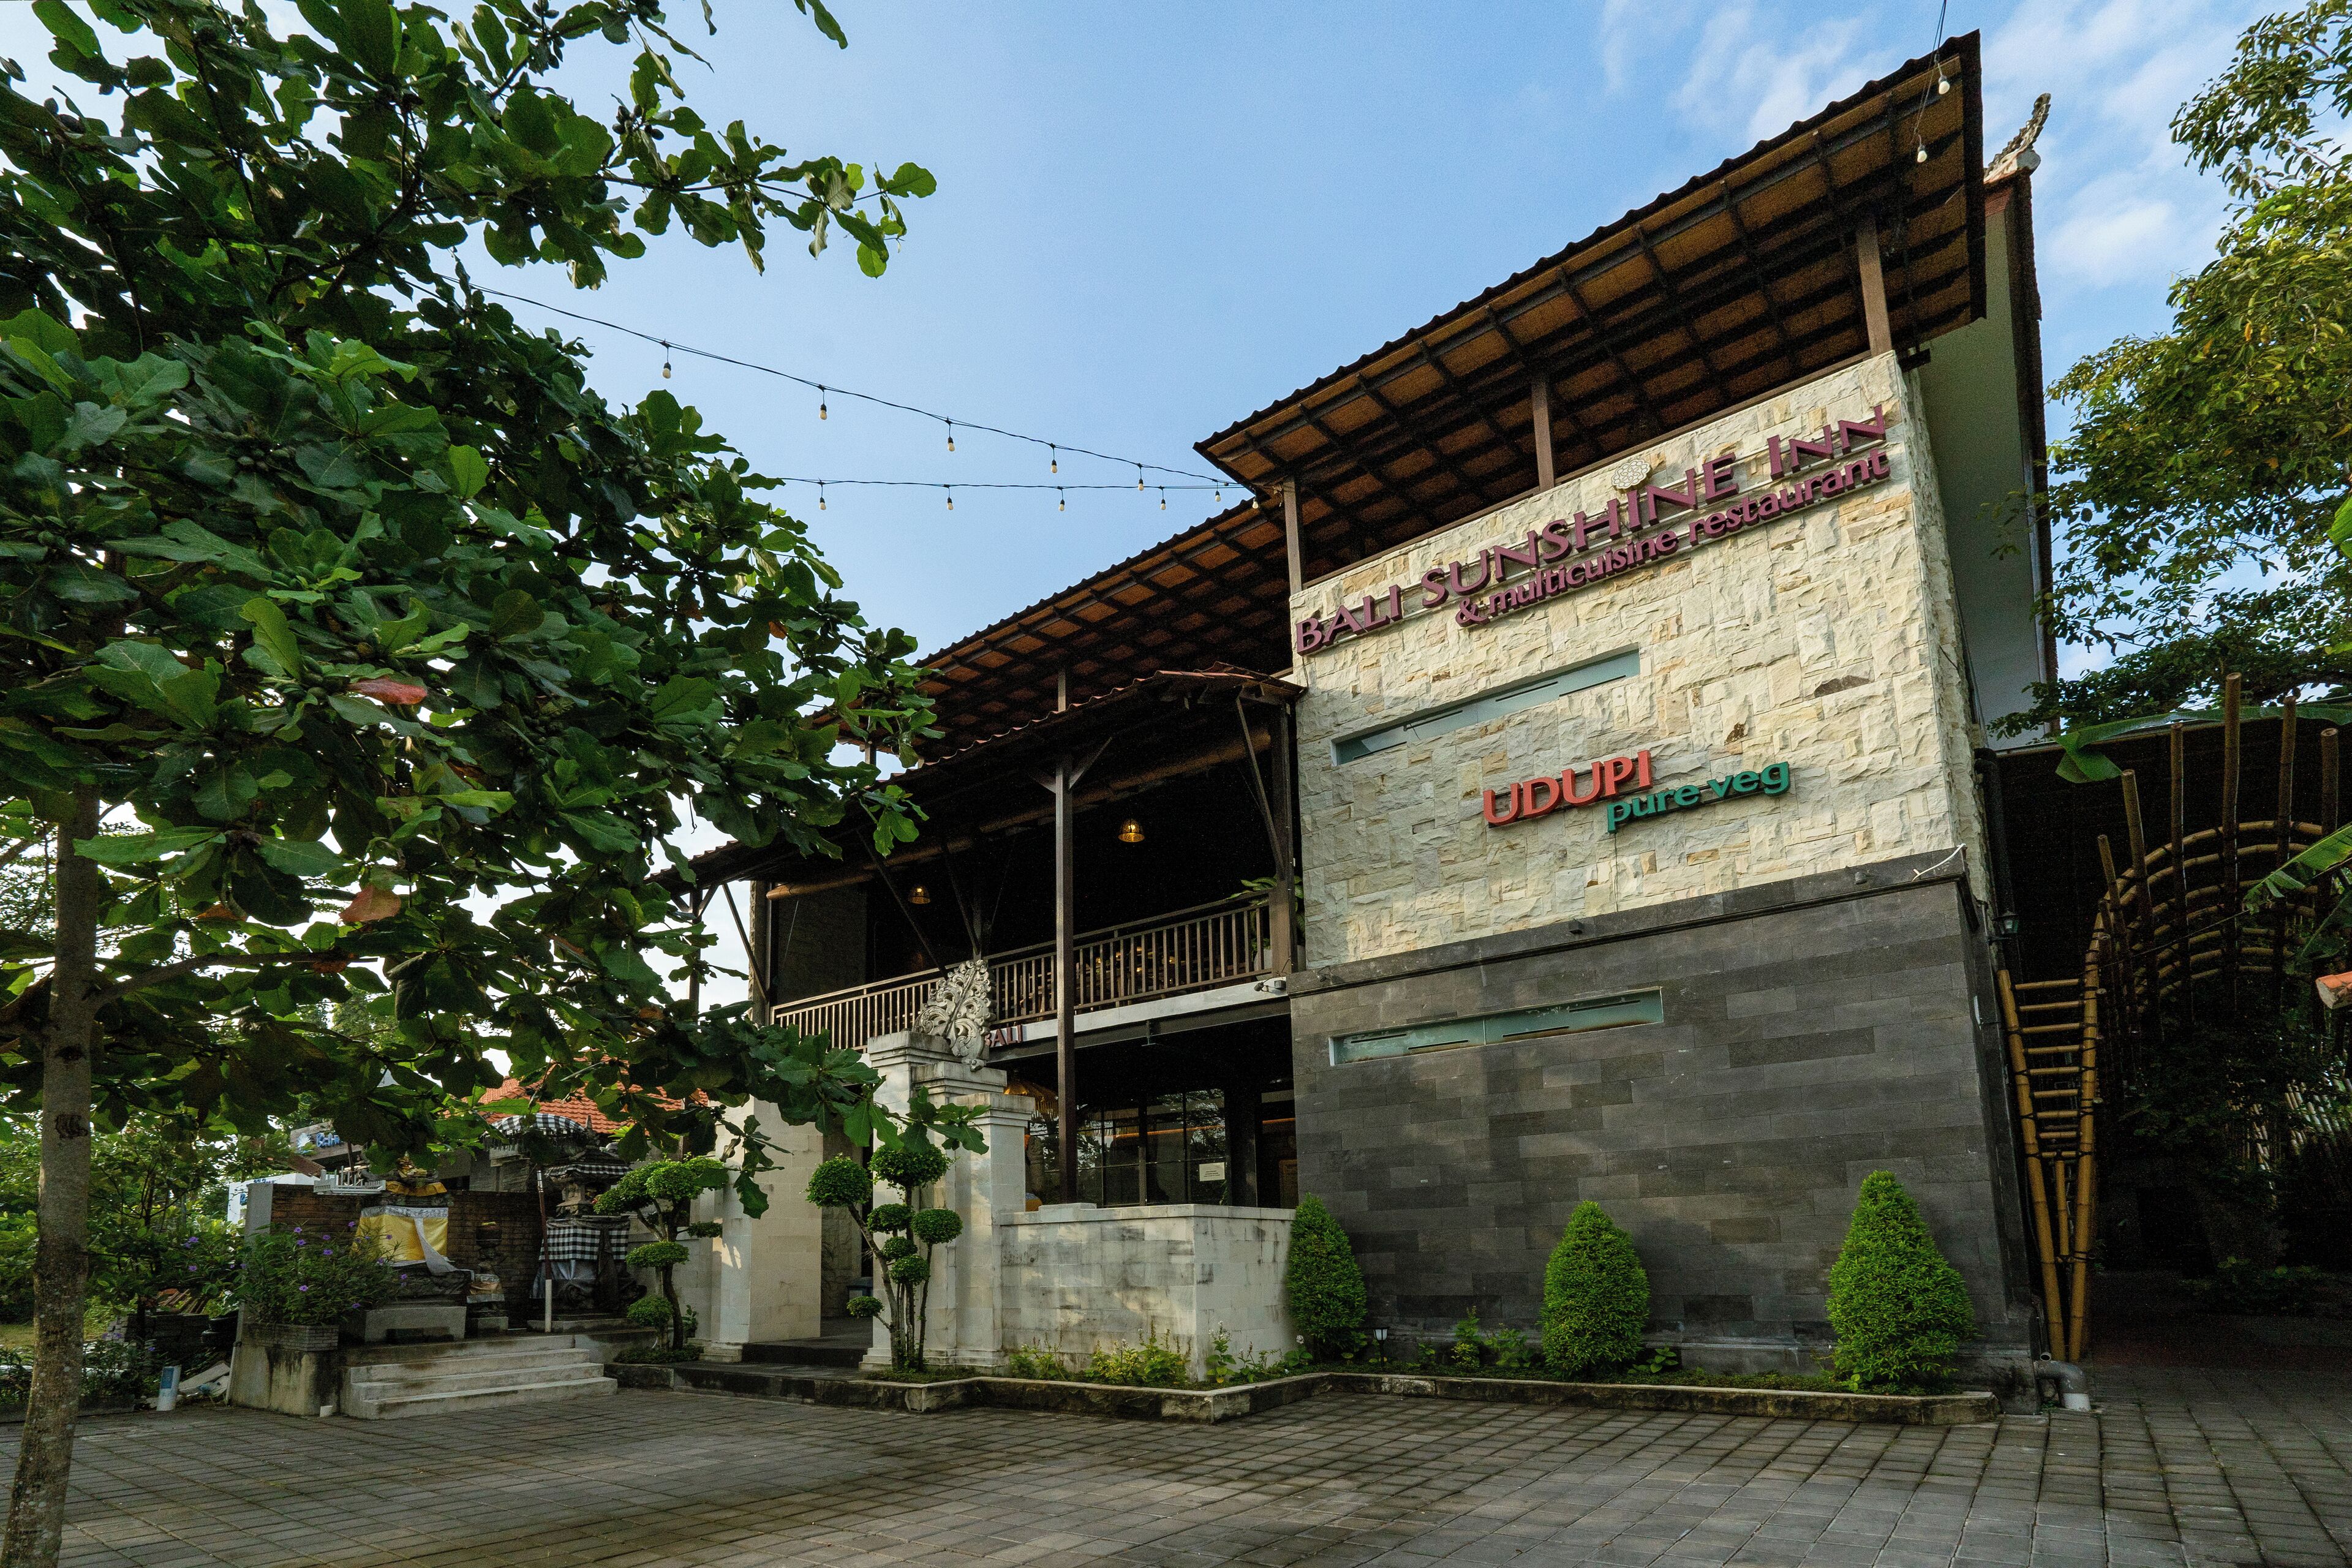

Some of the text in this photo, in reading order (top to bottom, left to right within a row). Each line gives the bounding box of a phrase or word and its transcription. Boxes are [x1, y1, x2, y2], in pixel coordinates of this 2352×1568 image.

[1296, 404, 1887, 656] BALI SUNSHINE INN
[1455, 448, 1891, 628] & multicuisine restaurant
[1483, 749, 1654, 827] UDUPI
[1607, 761, 1791, 834] pure veg
